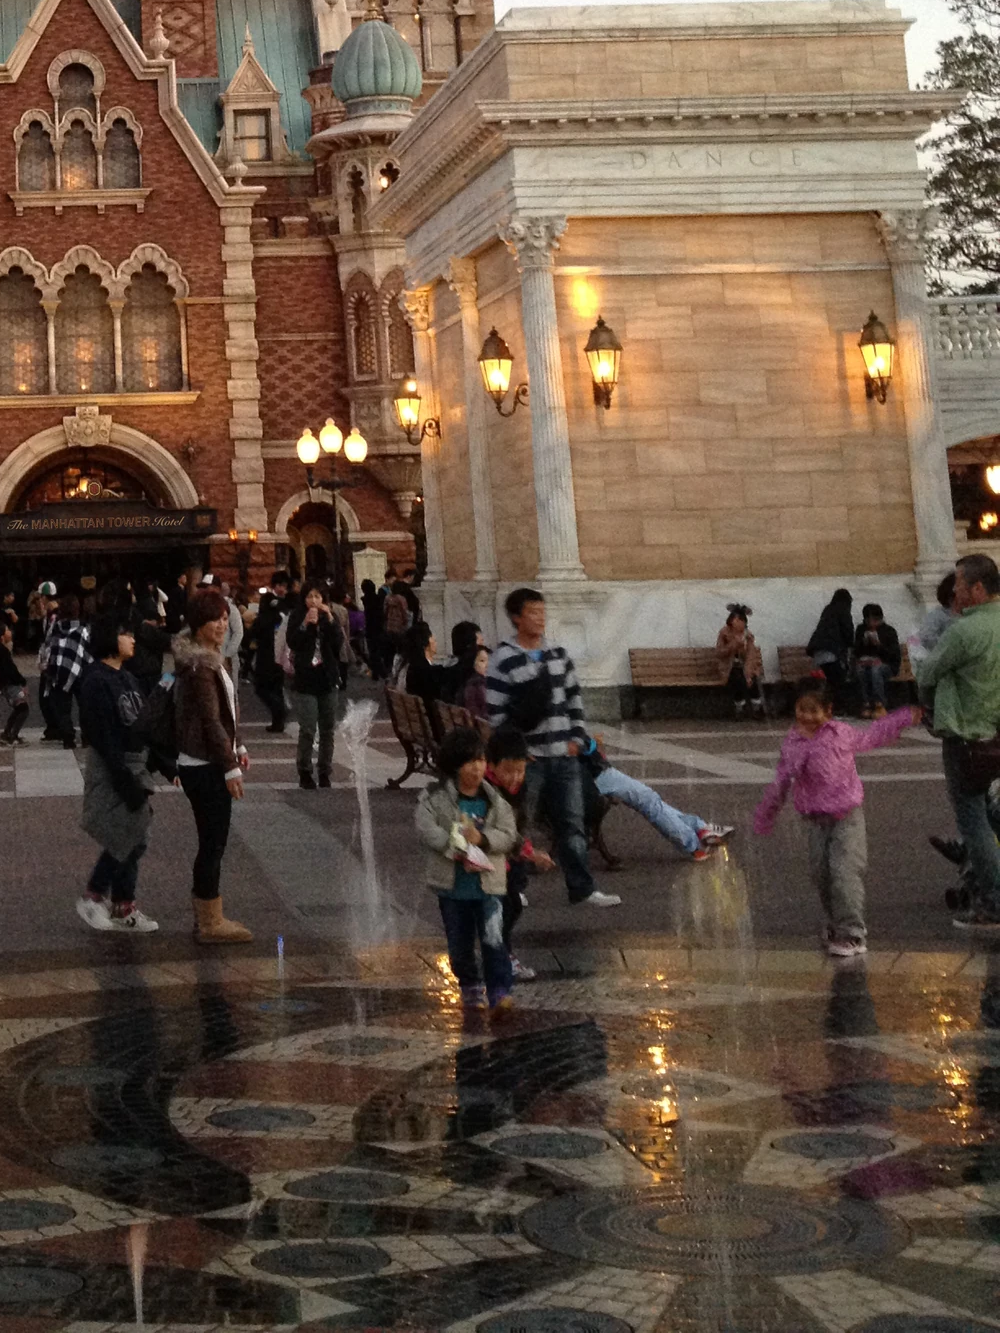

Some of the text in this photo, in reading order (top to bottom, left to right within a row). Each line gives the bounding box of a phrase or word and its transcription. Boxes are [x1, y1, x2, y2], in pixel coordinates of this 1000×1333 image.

[6, 516, 185, 530] The MANHATTAN TOWER Hotel
